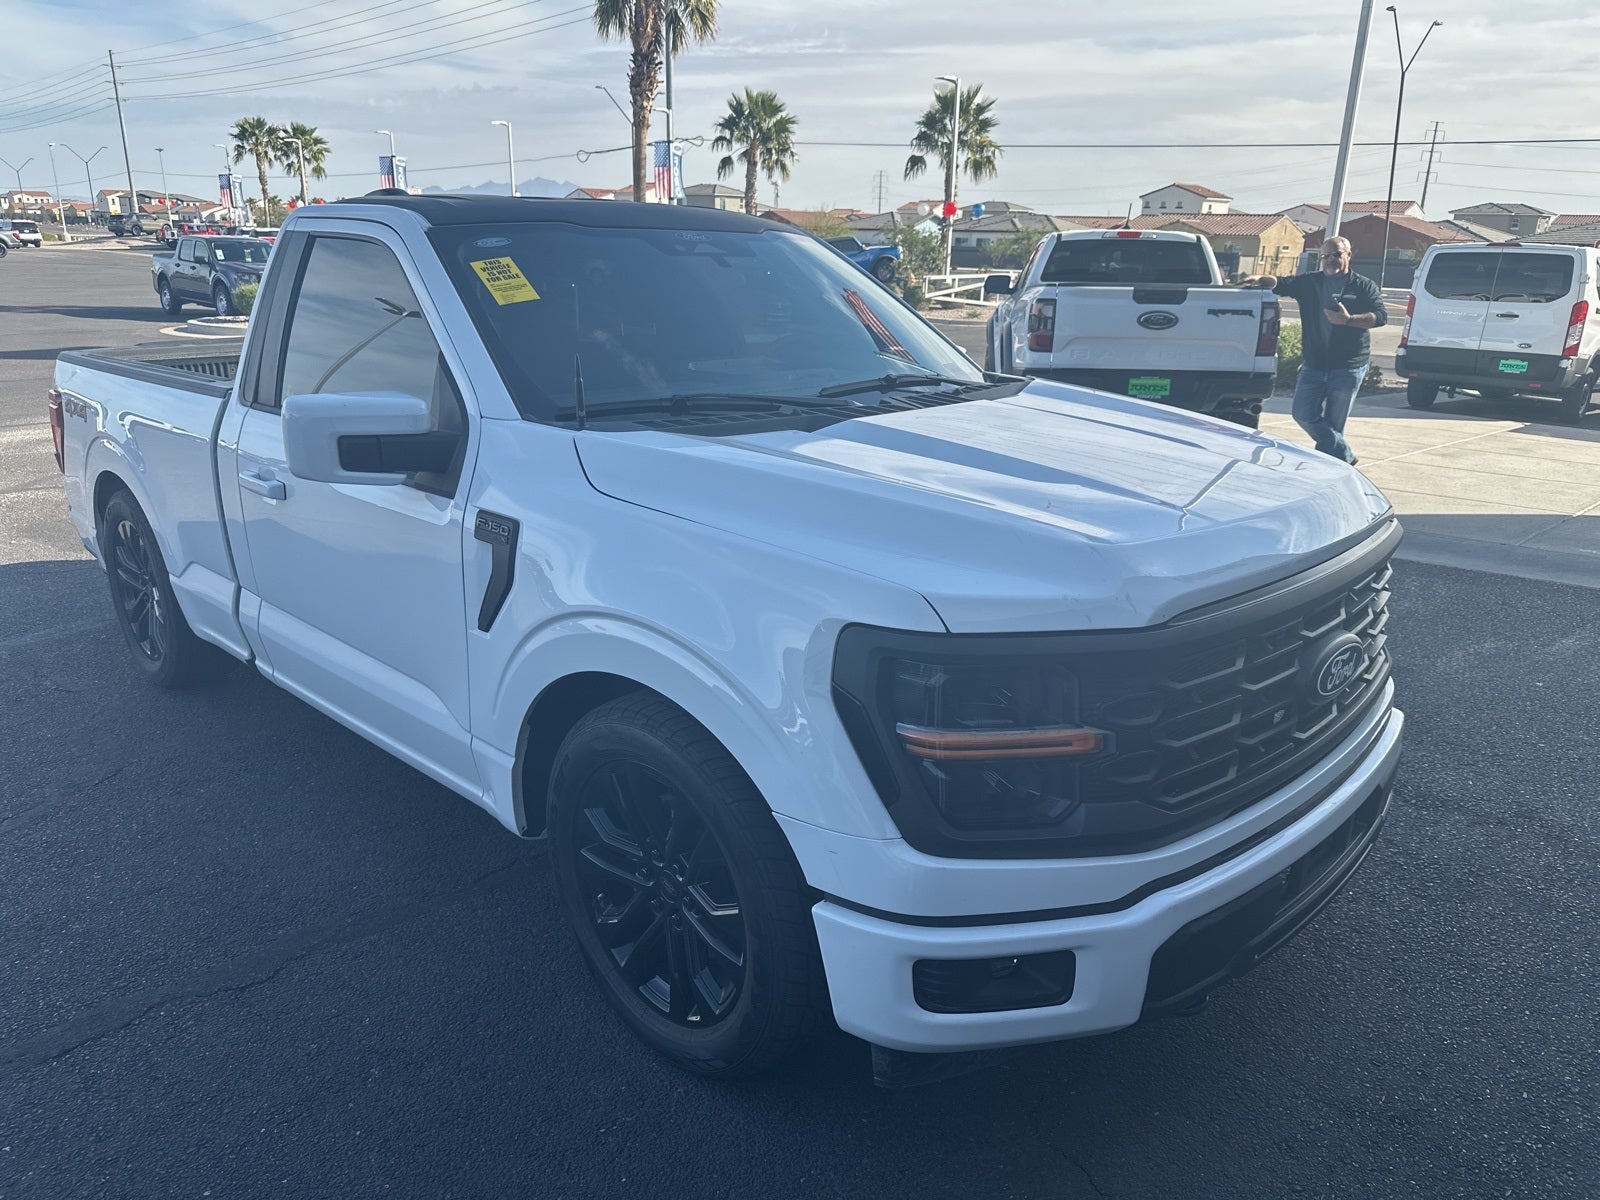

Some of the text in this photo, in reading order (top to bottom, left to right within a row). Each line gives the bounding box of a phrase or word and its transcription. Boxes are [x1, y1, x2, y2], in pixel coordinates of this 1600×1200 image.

[480, 263, 511, 272] VEHICLE
[486, 273, 521, 283] FOR SALE
[1327, 650, 1357, 690] Ford
